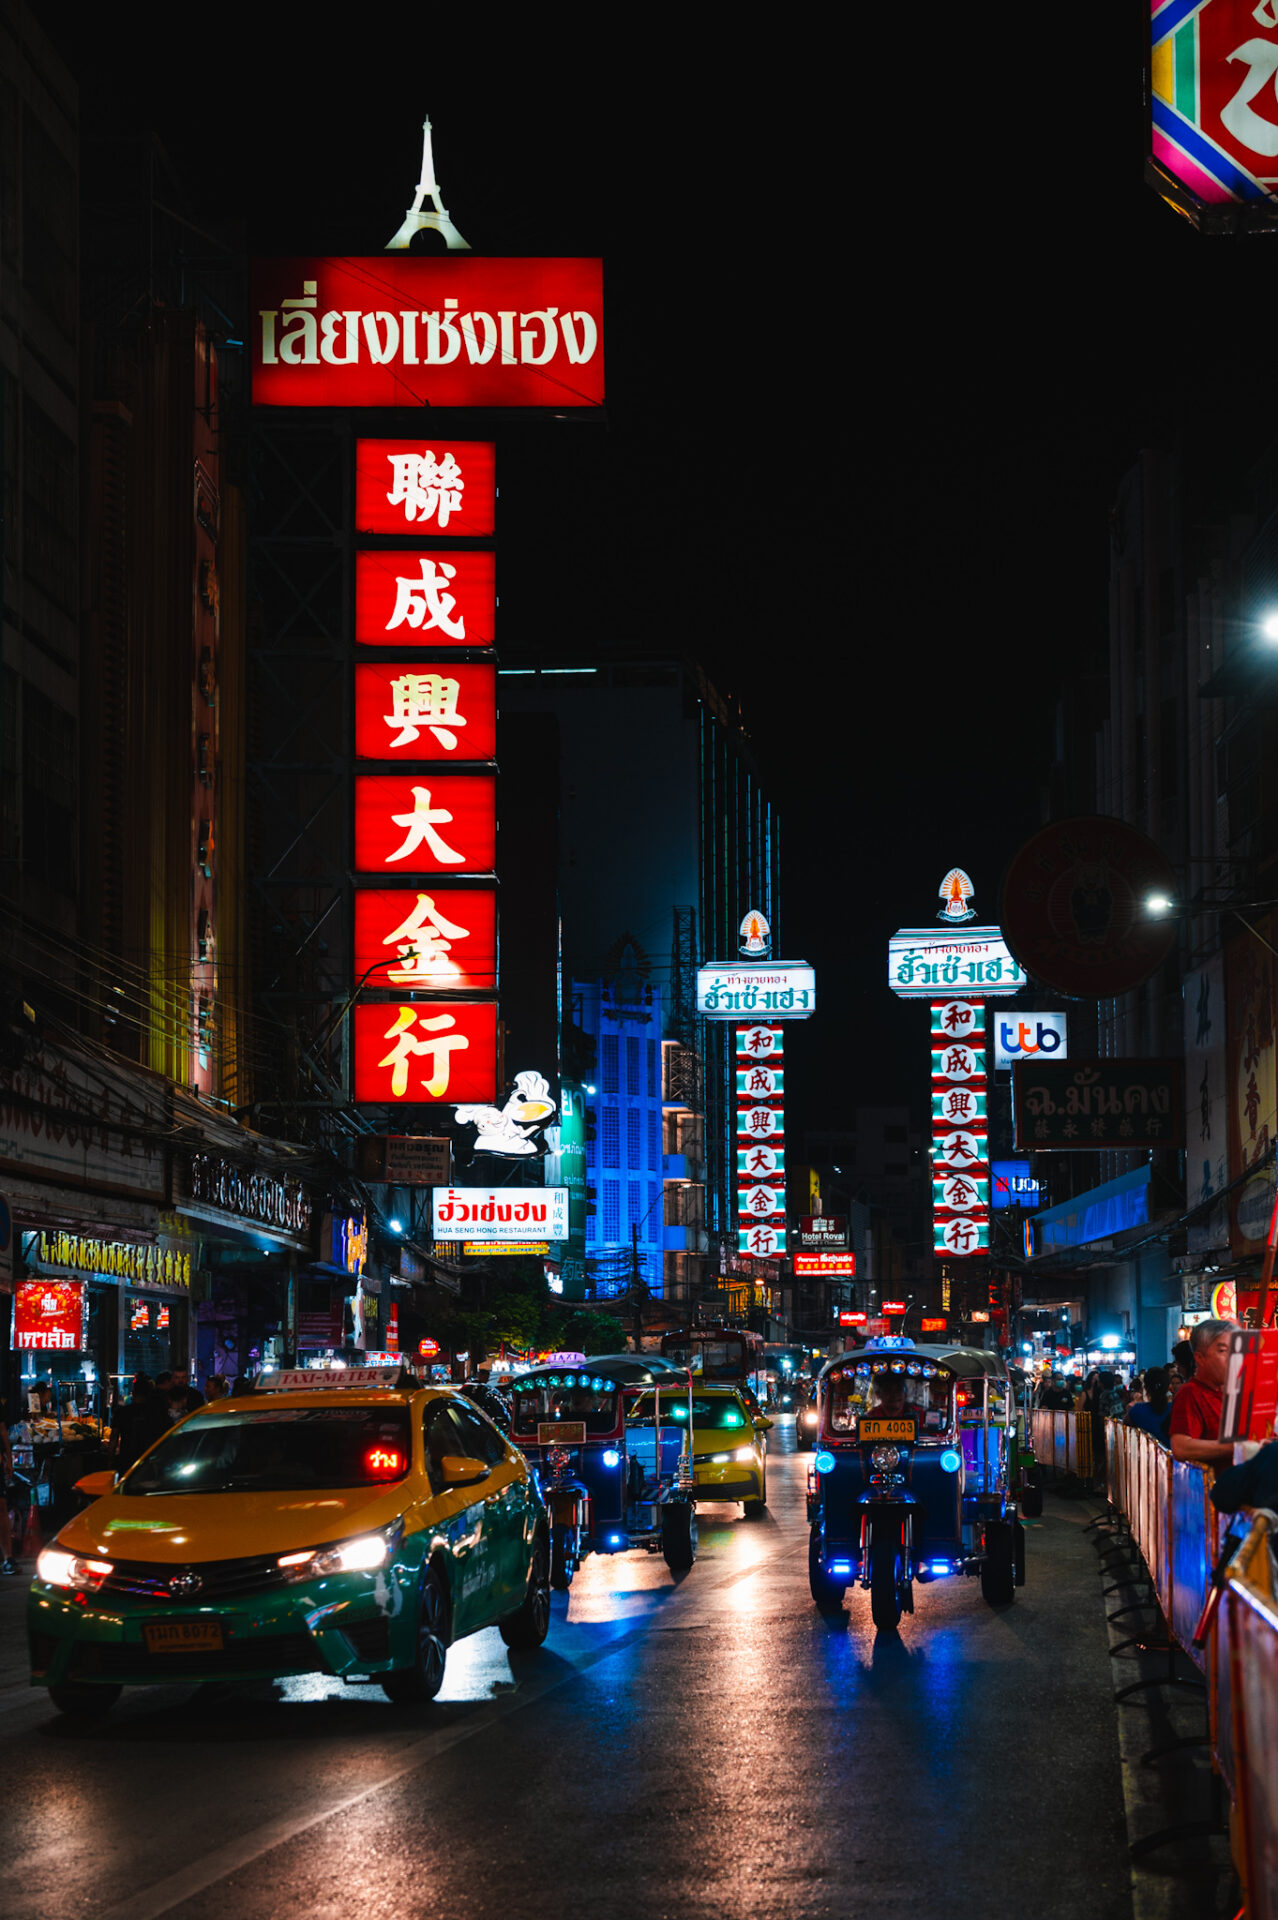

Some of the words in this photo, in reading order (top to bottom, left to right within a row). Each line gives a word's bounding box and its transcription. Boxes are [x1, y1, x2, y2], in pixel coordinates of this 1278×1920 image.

[259, 281, 598, 365] เลี่ยงเซ่งเฮง
[378, 450, 470, 1097] 聯成興大金行
[1001, 1022, 1061, 1053] ttb
[944, 1005, 975, 1251] 和成興大金行
[747, 1030, 774, 1253] 和成興大金行
[499, 1226, 547, 1234] RESTAURANT
[801, 1232, 822, 1240] Hotel
[18, 1326, 76, 1348] เกาลัด
[874, 1339, 905, 1347] TAXI
[553, 1353, 579, 1361] TAXI
[282, 1370, 378, 1385] TAXI-METER
[886, 1422, 913, 1433] 4003
[369, 1450, 398, 1468] ว่าง
